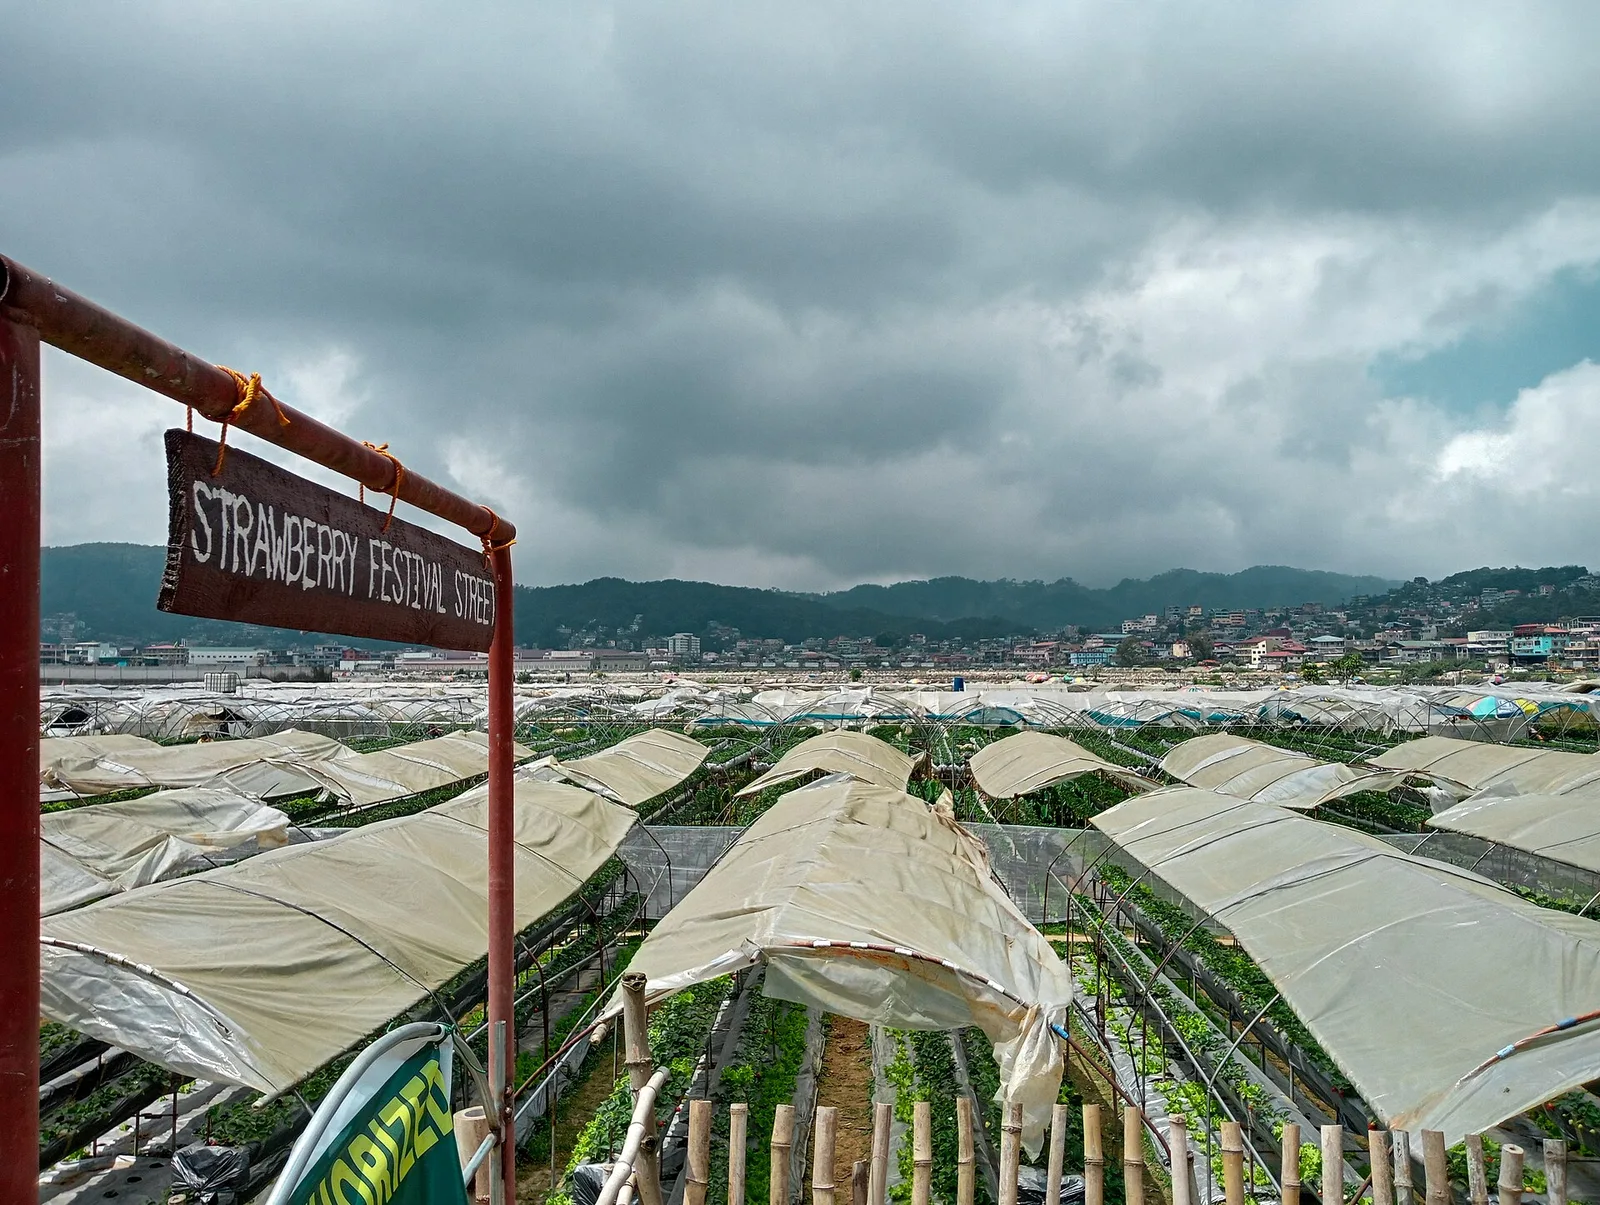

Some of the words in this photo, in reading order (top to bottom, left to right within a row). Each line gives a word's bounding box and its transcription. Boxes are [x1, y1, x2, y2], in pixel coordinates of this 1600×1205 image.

[191, 480, 358, 596] STRAWBERRY
[369, 539, 446, 614] FESTIVAL
[455, 569, 495, 627] STREET
